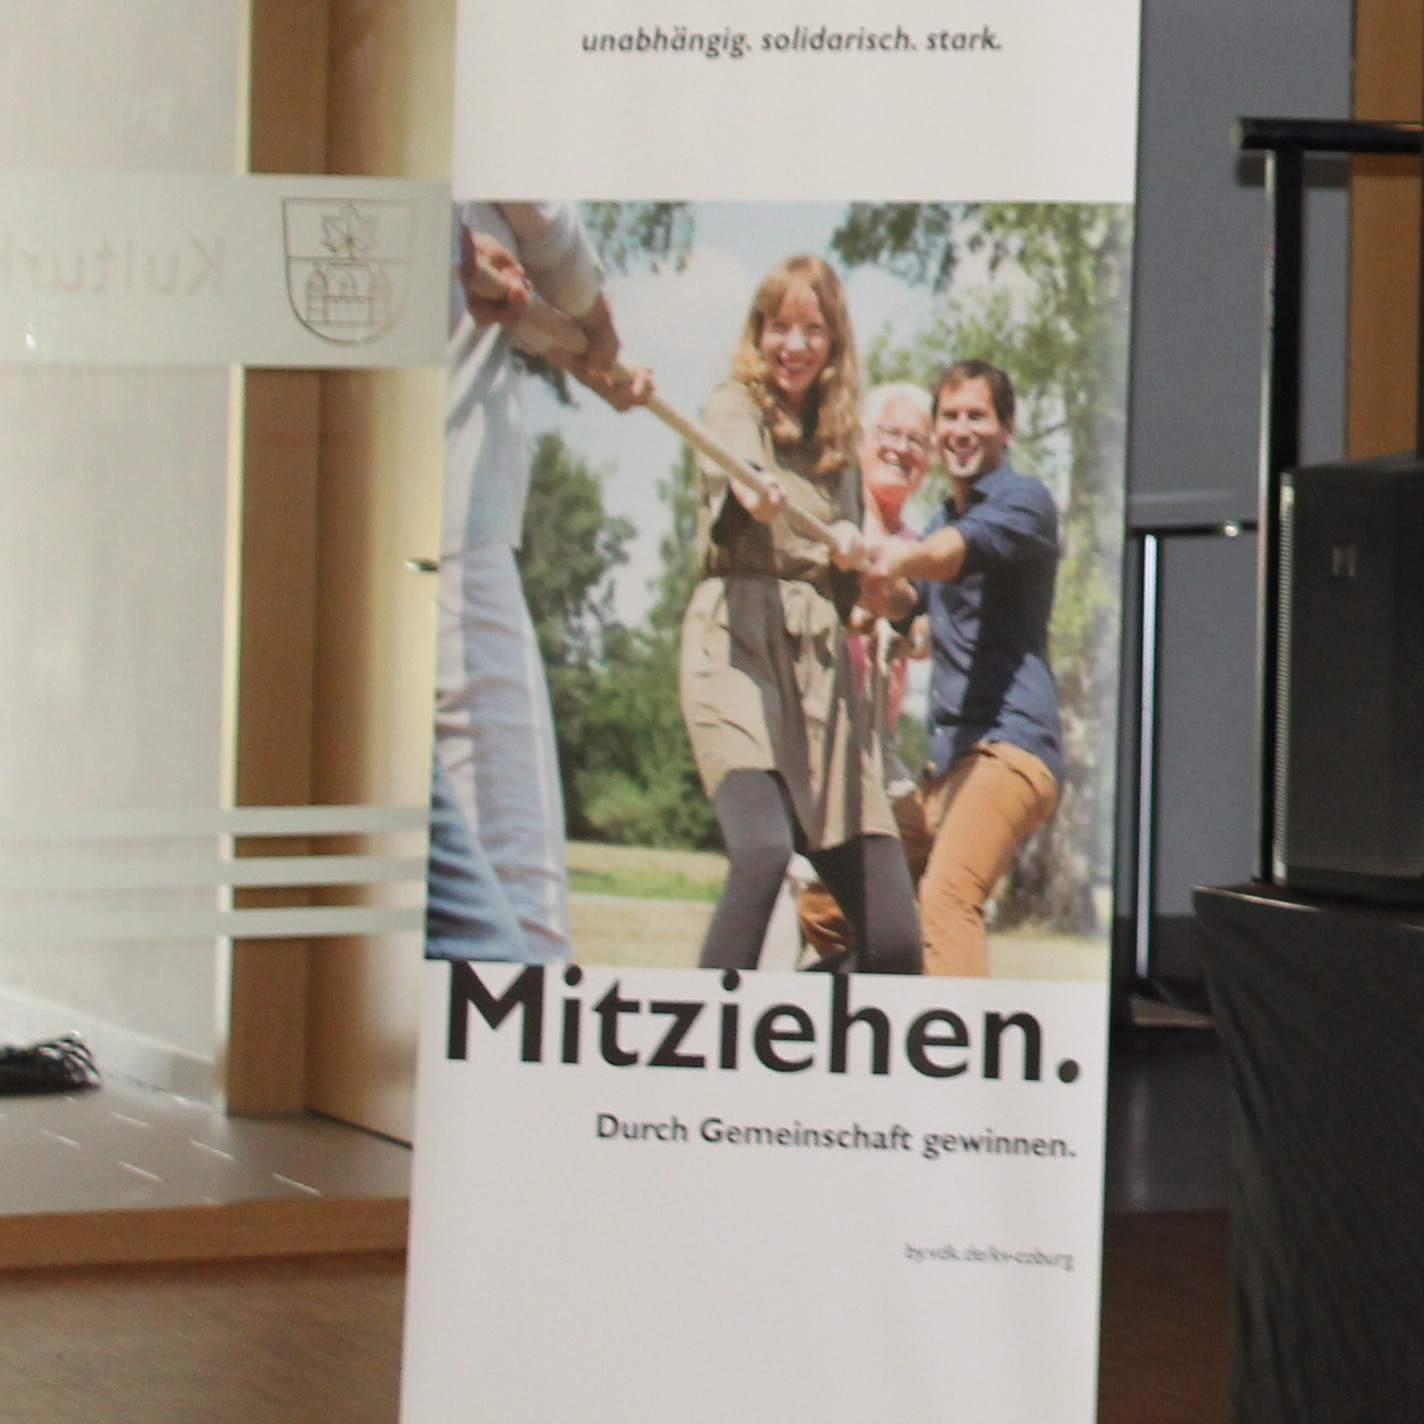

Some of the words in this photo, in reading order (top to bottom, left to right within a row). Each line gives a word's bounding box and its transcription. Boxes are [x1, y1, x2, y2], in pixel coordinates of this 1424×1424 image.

[581, 23, 753, 61] unabhängig.
[760, 23, 918, 54] solidarisch.
[925, 23, 1004, 53] stark.
[445, 959, 1081, 1085] Mitziehen.
[595, 1110, 690, 1145] Durch
[698, 1116, 914, 1155] Gemeinschaft
[921, 1127, 1078, 1162] gewinnen.
